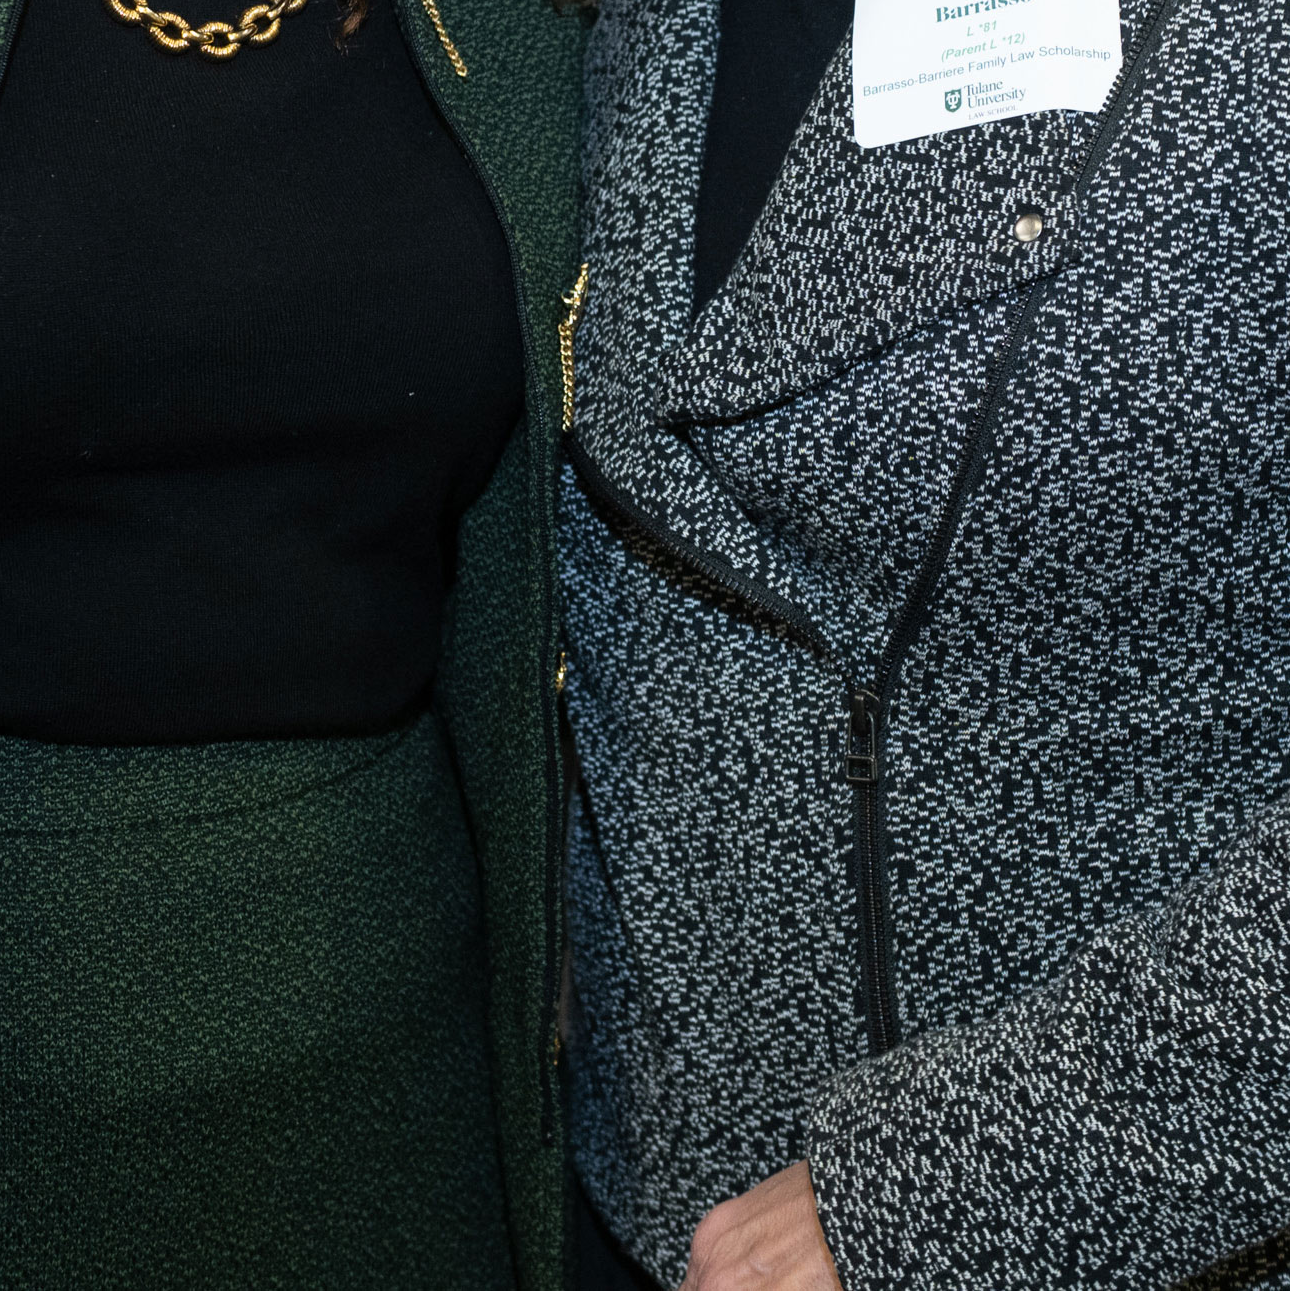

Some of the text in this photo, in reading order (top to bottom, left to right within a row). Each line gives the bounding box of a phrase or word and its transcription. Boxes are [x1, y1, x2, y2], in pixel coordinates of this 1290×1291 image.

[966, 26, 974, 37] L
[941, 42, 986, 62] (Parent
[989, 38, 997, 50] L
[862, 46, 1111, 97] Barrasso-Barriere Family Law Scholarship
[964, 81, 1003, 97] Tulane
[967, 87, 1026, 109] University
